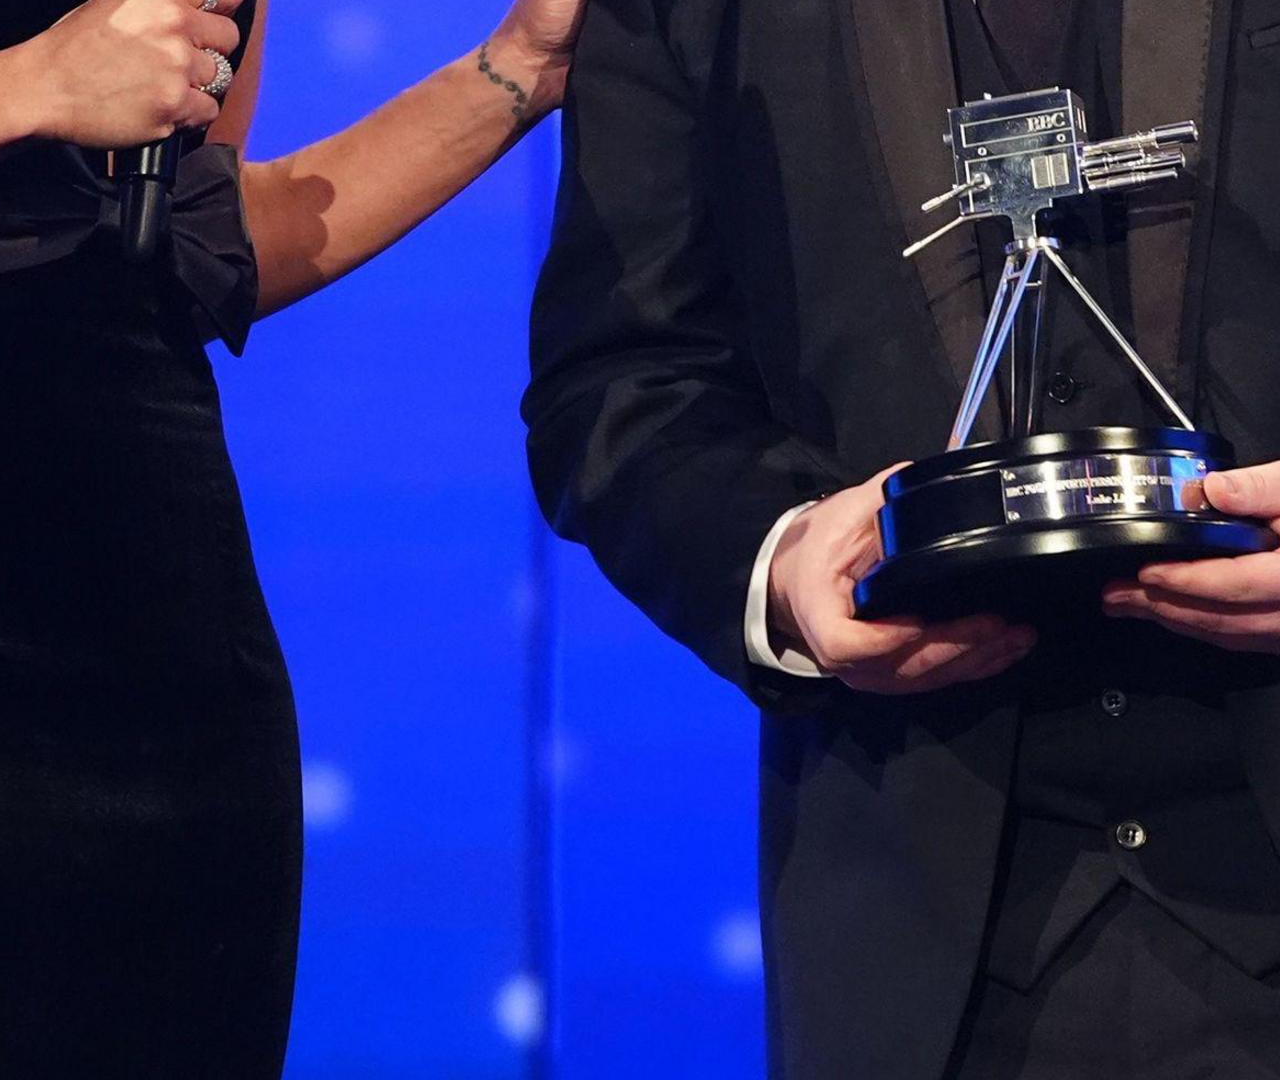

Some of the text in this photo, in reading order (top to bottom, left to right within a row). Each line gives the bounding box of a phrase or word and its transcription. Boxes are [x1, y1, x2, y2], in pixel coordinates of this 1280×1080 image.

[1026, 112, 1066, 133] BBC
[1089, 475, 1146, 487] PERSONITY
[1086, 494, 1113, 505] Luke
